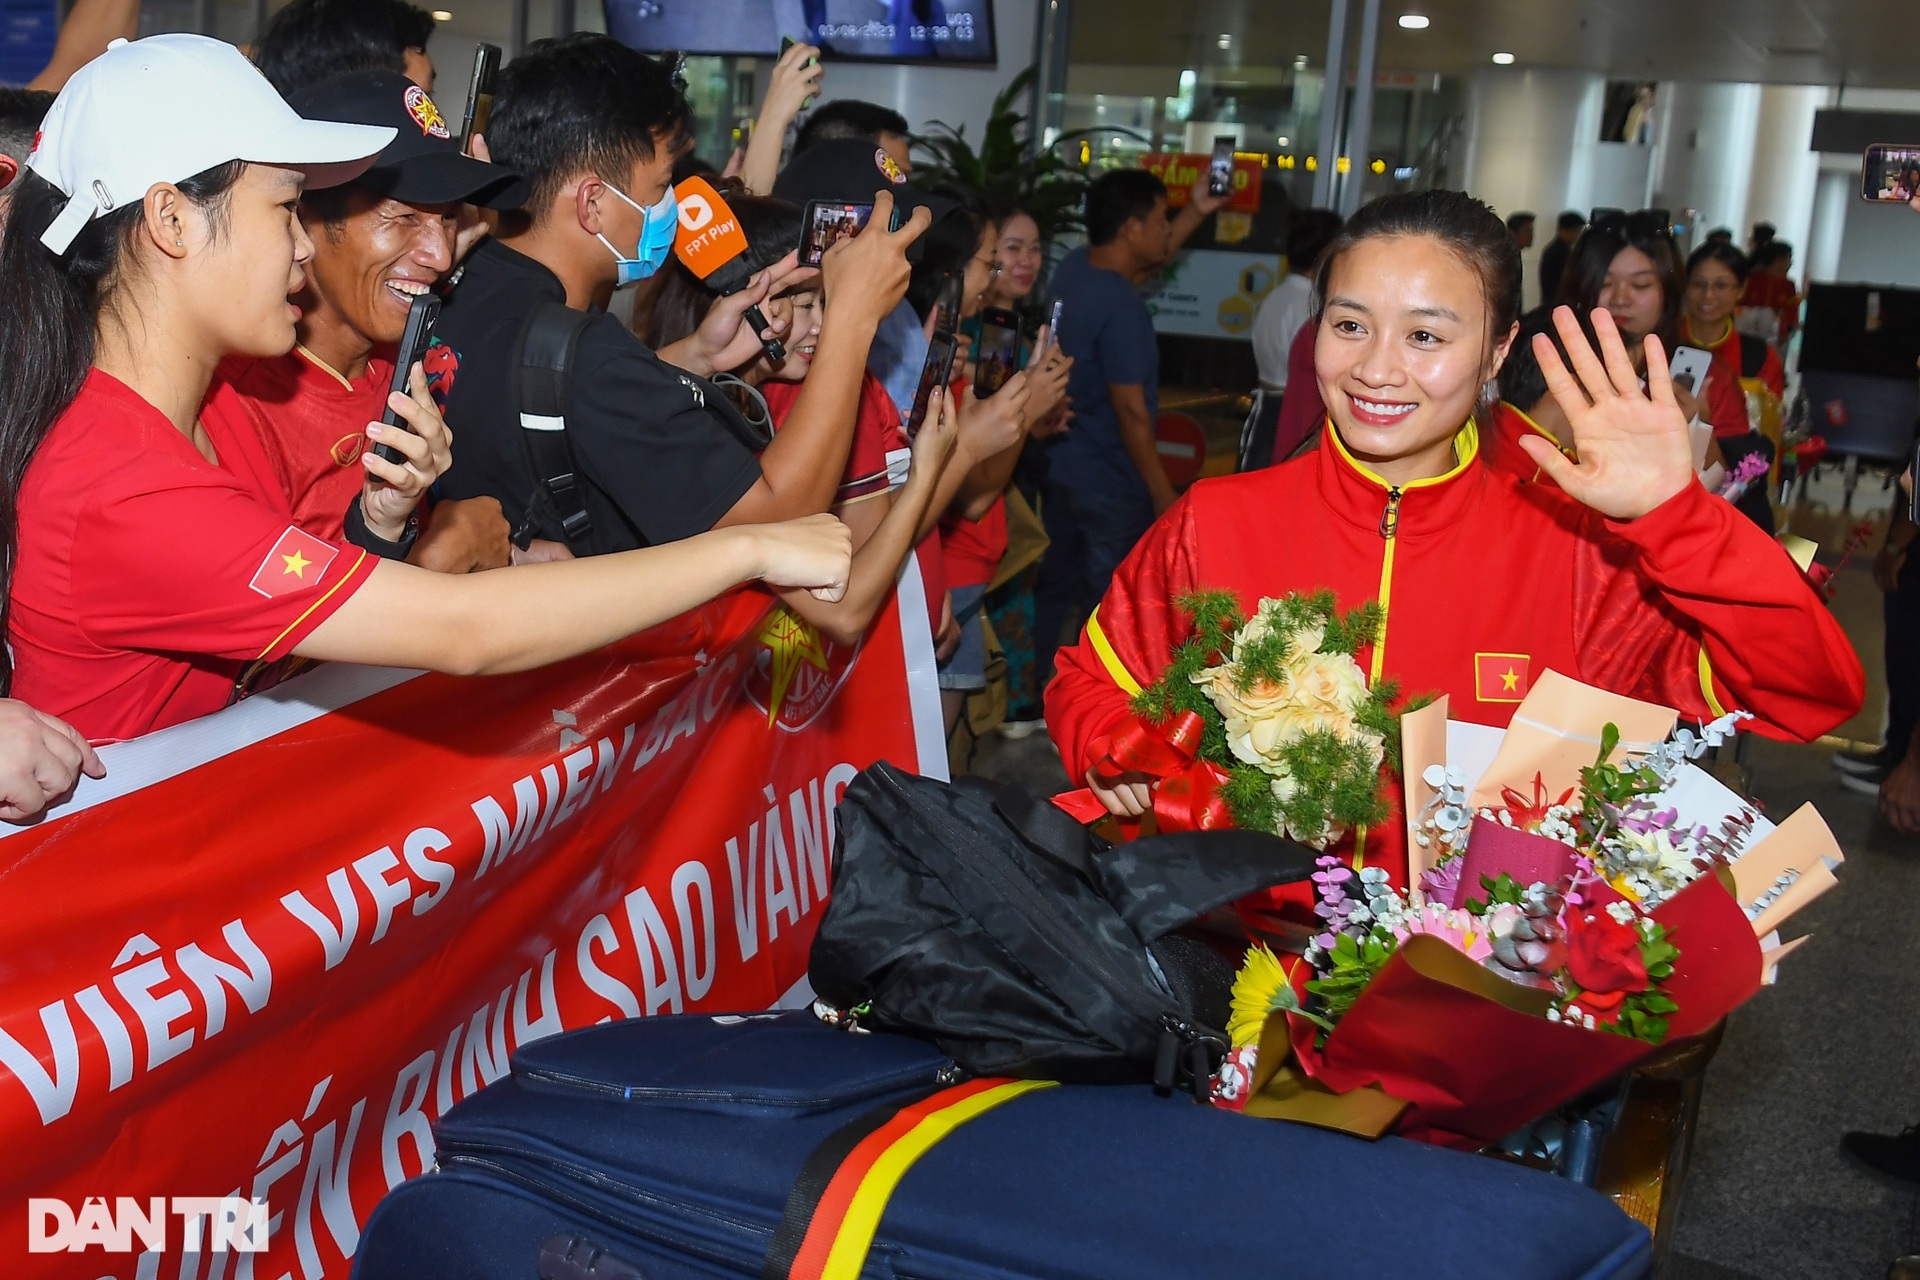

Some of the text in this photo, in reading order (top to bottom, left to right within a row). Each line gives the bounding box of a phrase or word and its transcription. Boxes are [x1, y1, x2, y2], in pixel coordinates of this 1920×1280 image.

[684, 218, 735, 257] FPT Play
[0, 932, 272, 1126] VIÊN
[279, 826, 456, 971] VFS
[471, 708, 635, 881] MIỀN
[381, 948, 564, 1188] BINH
[576, 860, 716, 1025] SAO
